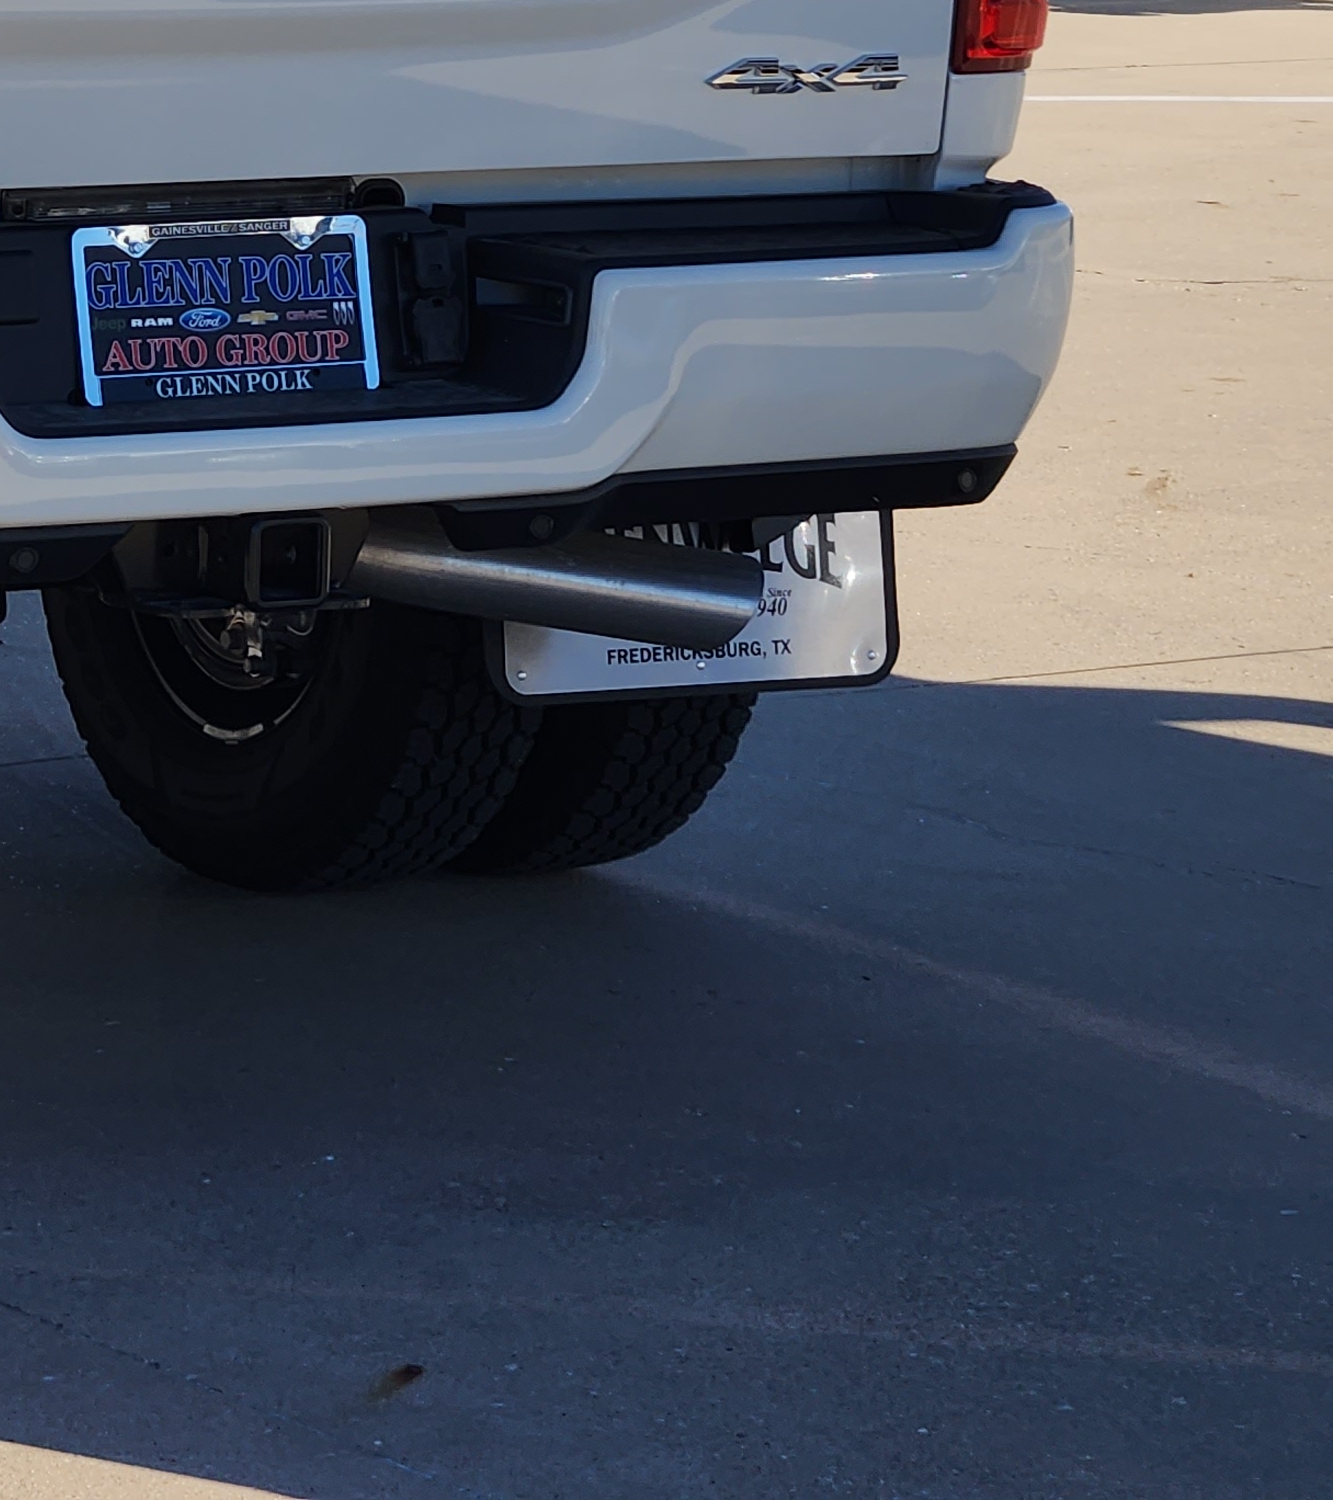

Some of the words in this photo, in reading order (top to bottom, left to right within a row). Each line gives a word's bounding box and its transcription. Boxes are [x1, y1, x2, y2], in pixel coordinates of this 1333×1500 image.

[85, 257, 231, 309] GLENN
[239, 252, 357, 302] POLK
[130, 317, 174, 328] RAM
[188, 311, 222, 329] Ford
[286, 309, 327, 321] GMC
[103, 335, 208, 371] AUTO
[215, 330, 349, 366] GROUP
[156, 373, 244, 398] GLENN
[246, 369, 313, 393] POLK
[756, 597, 788, 617] 940
[771, 639, 792, 655] TX
